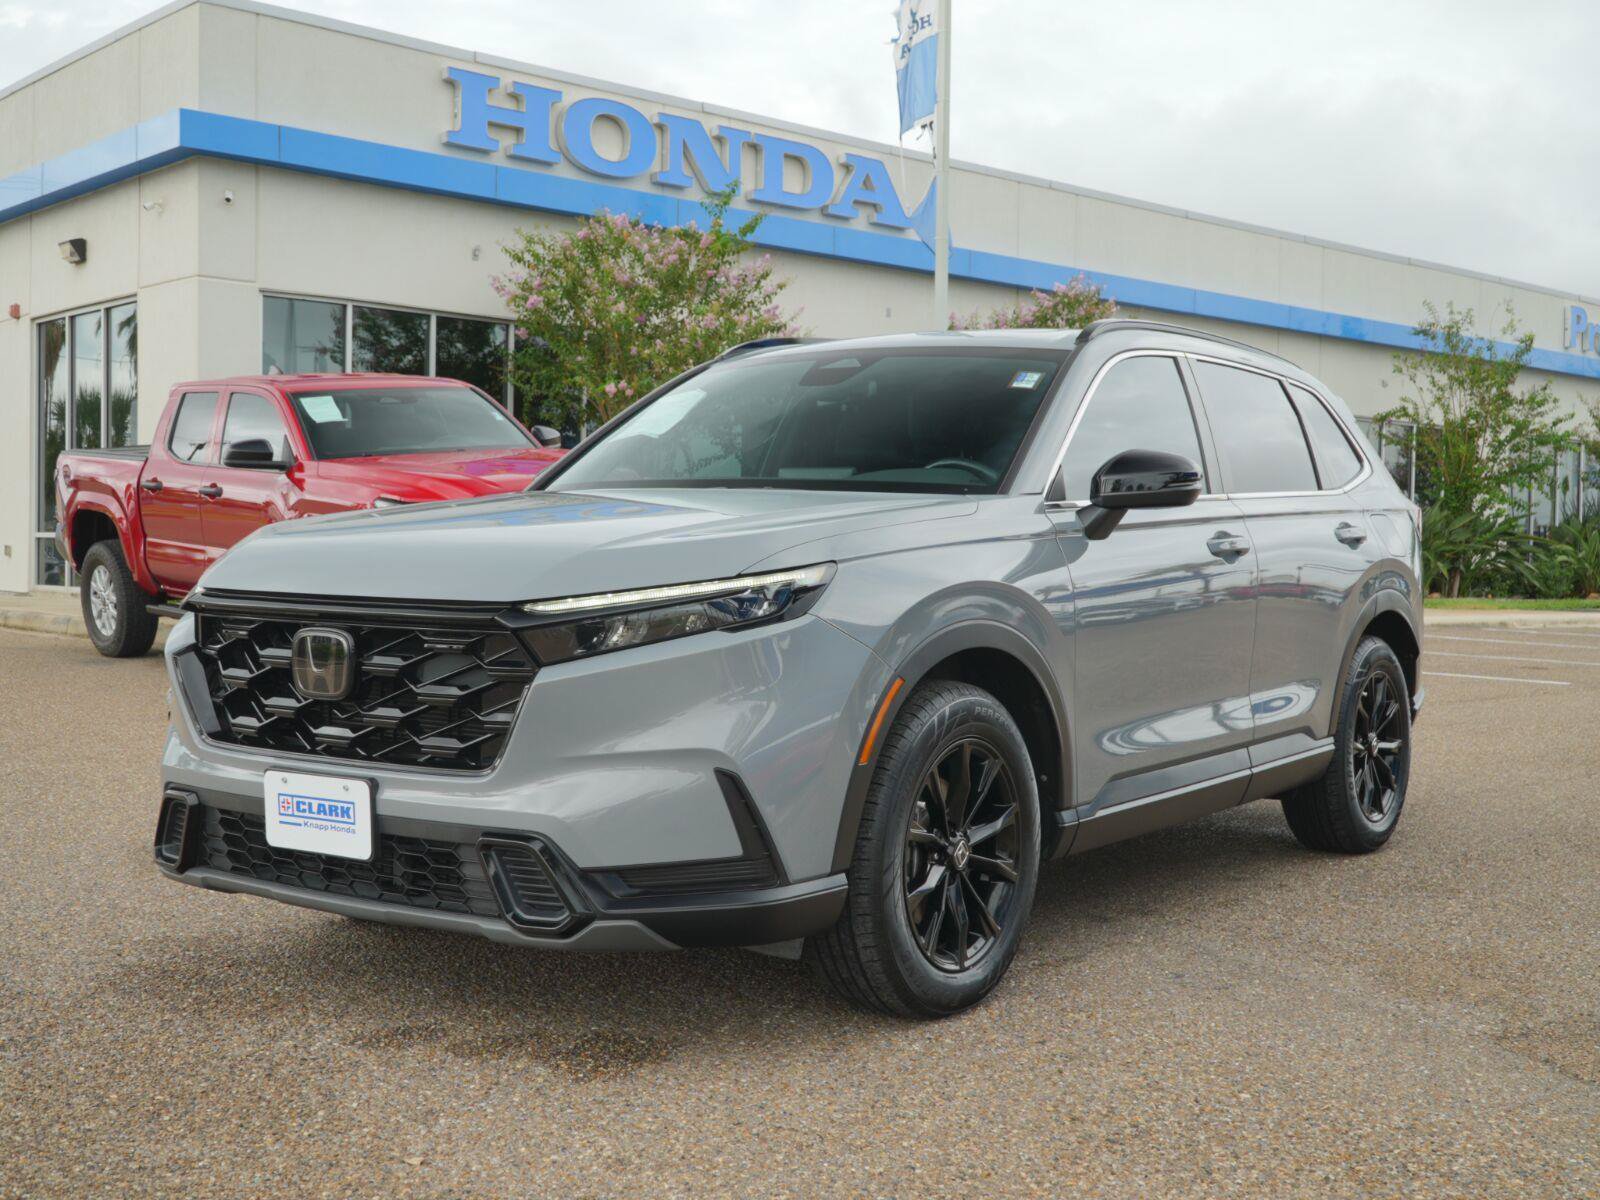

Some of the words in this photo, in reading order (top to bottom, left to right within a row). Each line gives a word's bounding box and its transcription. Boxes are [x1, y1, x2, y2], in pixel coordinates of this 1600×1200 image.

[442, 66, 909, 230] HONDA
[295, 800, 352, 819] CLARK
[303, 820, 329, 832] Knapp
[330, 822, 356, 834] Honda
